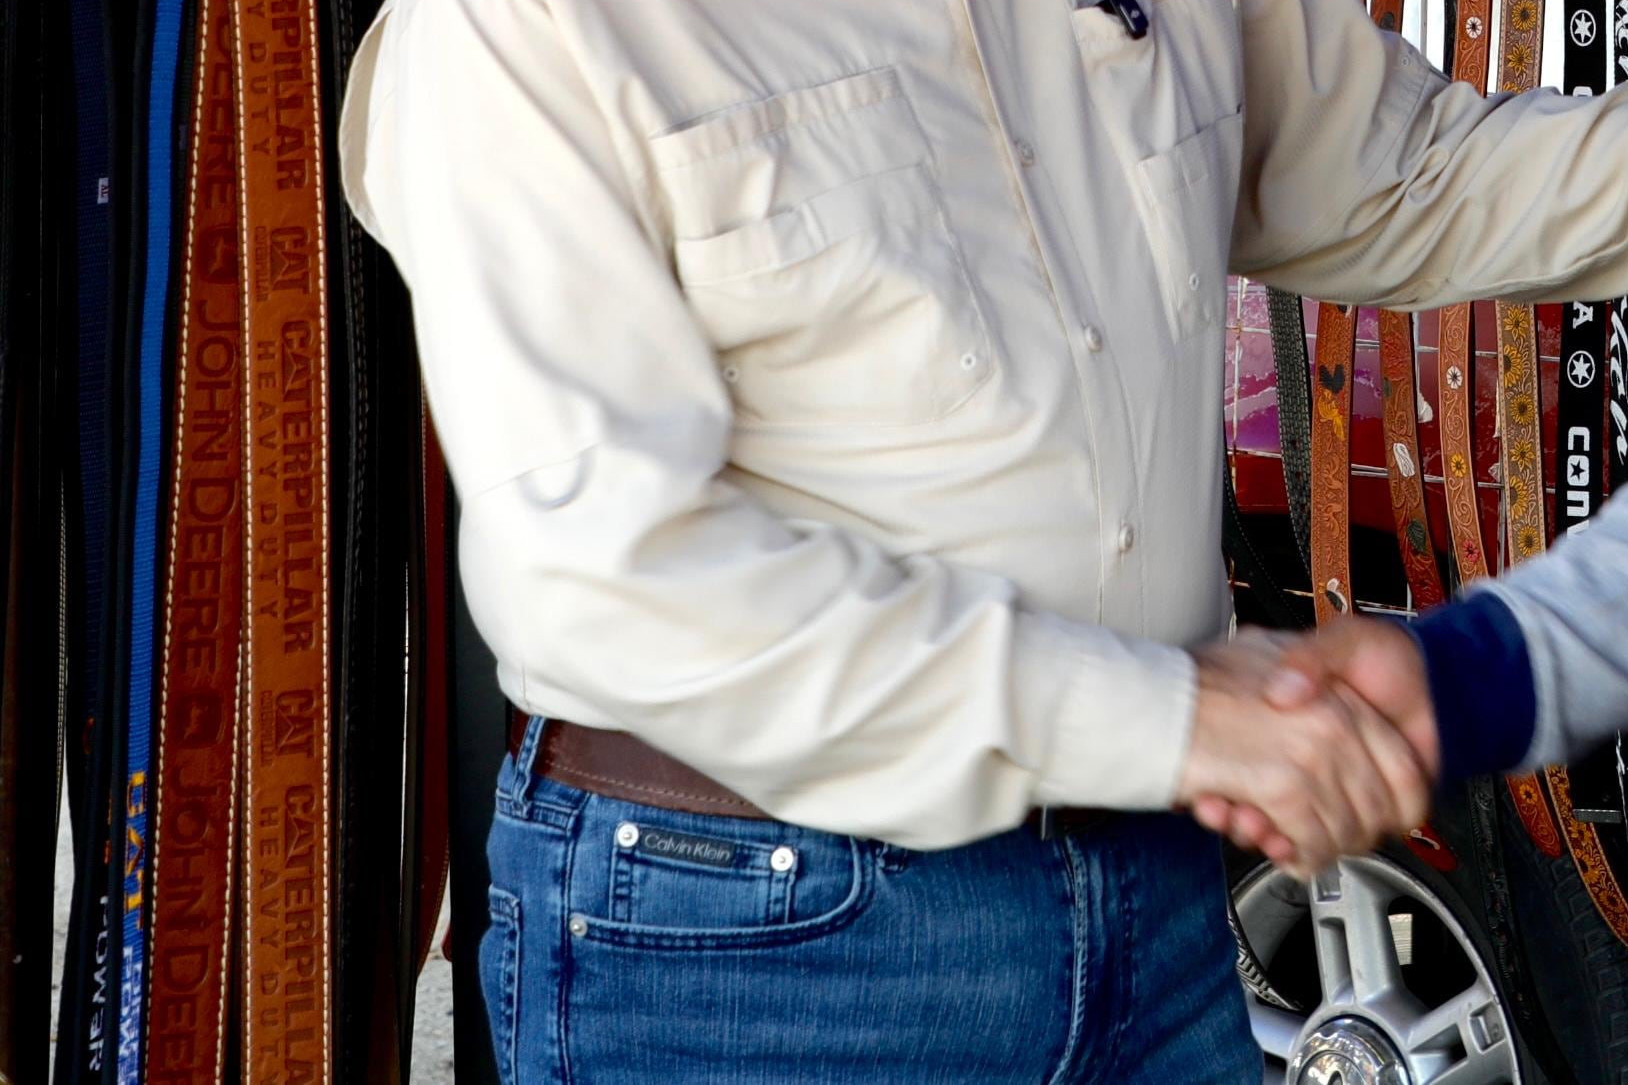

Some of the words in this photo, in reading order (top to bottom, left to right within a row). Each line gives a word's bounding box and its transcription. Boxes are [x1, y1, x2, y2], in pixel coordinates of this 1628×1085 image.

[248, 41, 270, 157] DUTY
[269, 225, 309, 295] CAT
[257, 342, 279, 480] HEAVY
[282, 320, 315, 654] CATERPILLAR
[179, 477, 237, 678] DEERE
[258, 504, 279, 620] DUTY
[274, 689, 316, 760] CAT
[162, 759, 218, 932] JOHN
[259, 807, 280, 949] HEAVY
[643, 832, 693, 857] Calvin
[692, 842, 731, 863] Klein
[283, 784, 316, 1085] CATERPILLA
